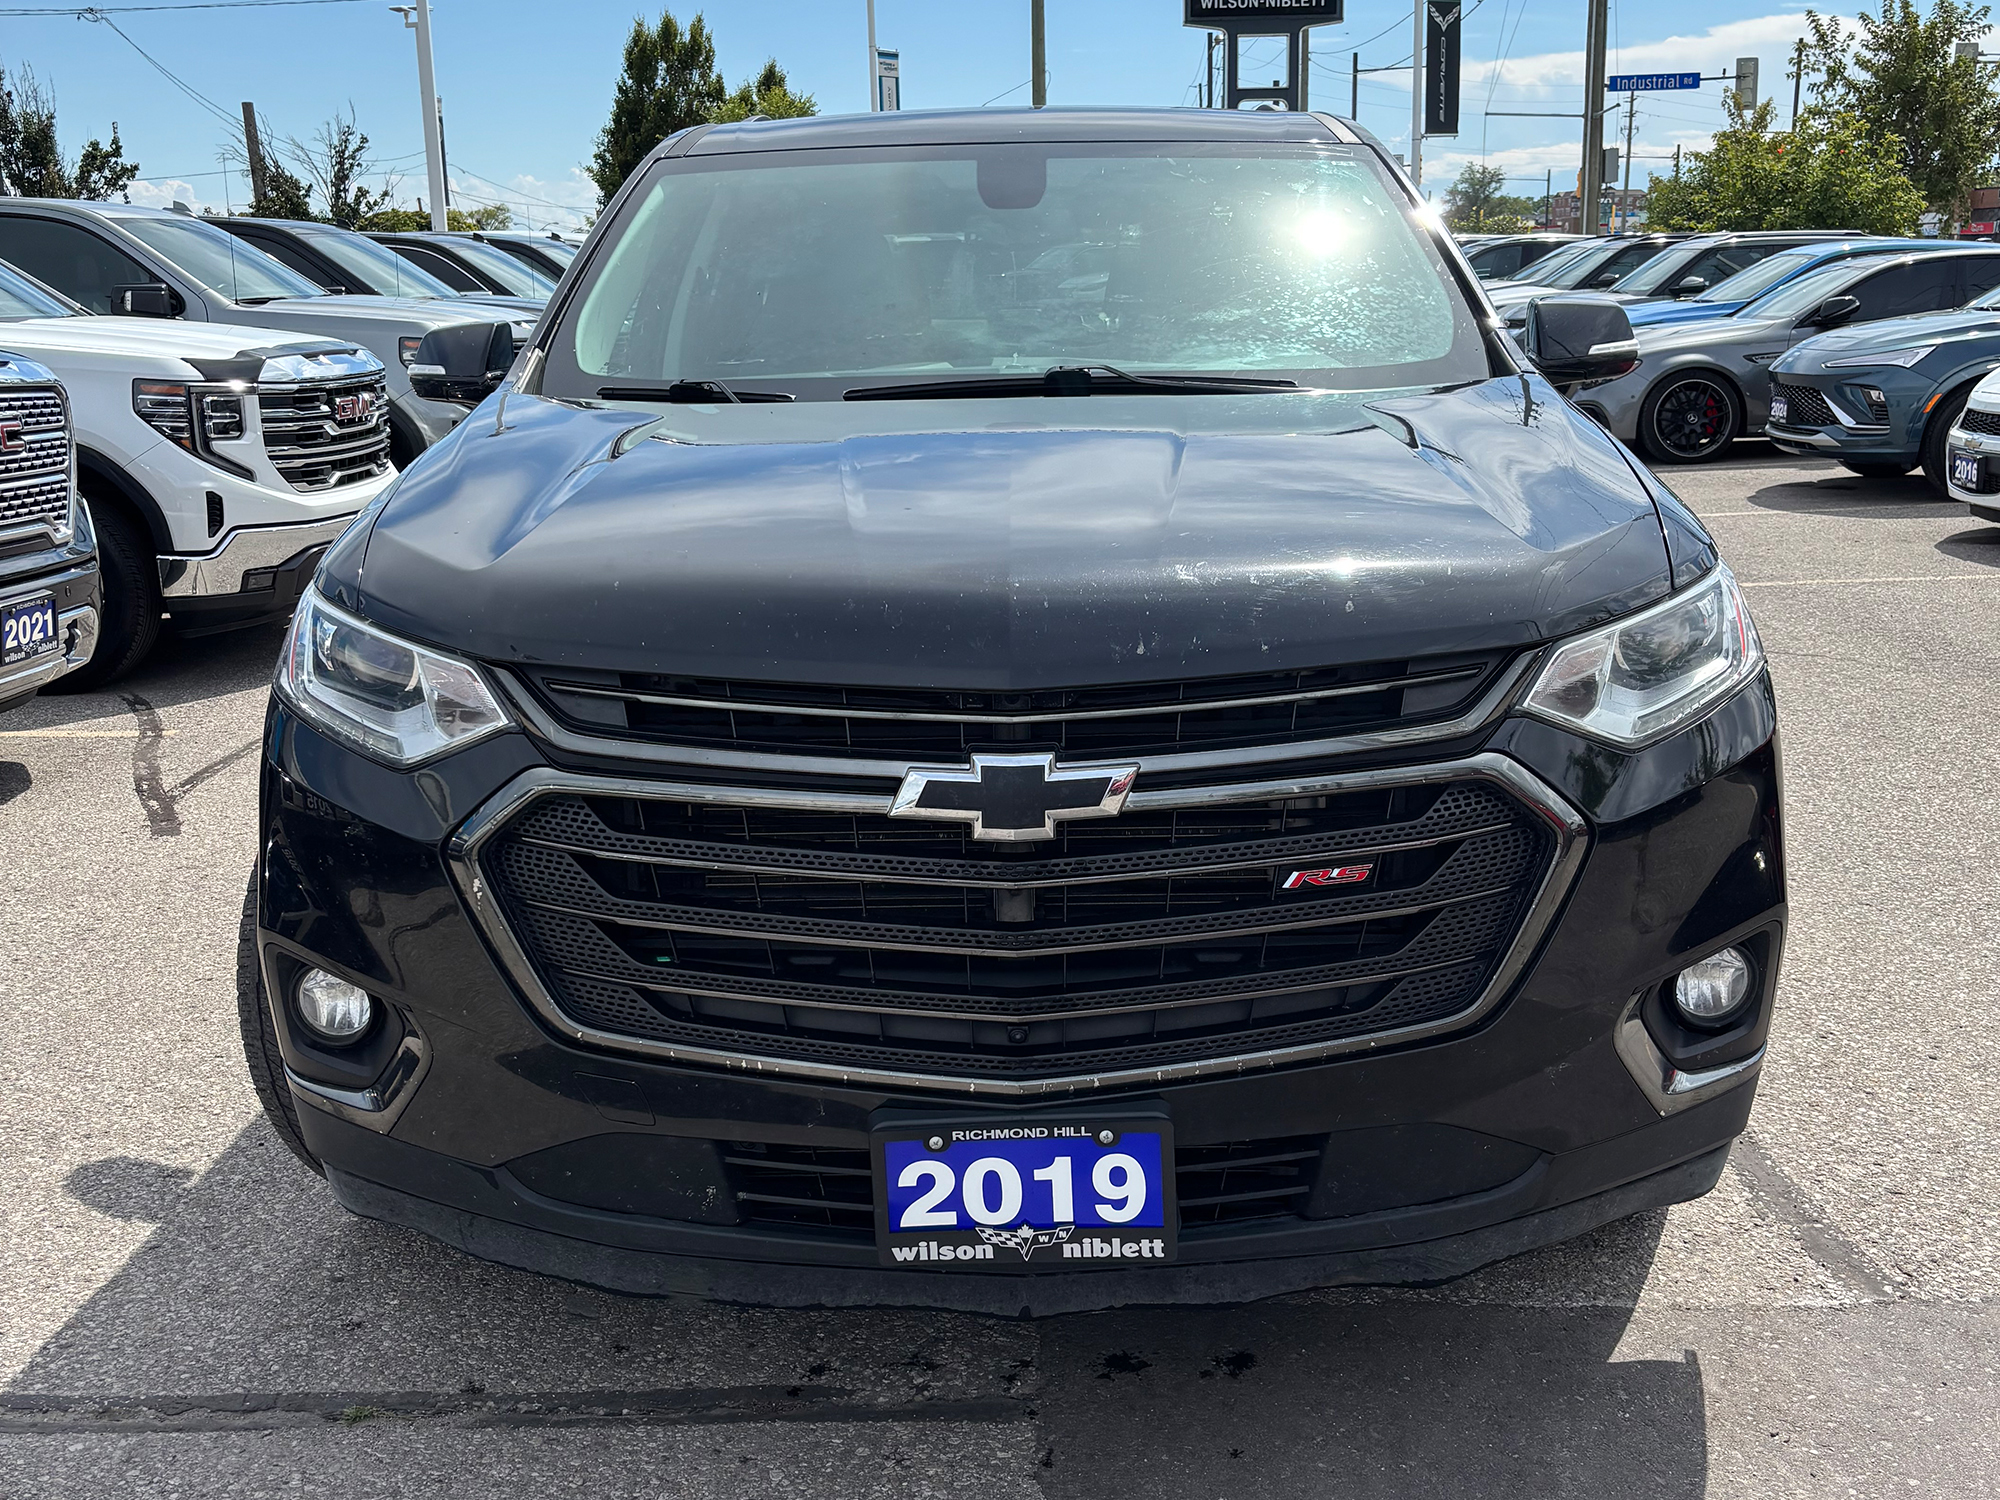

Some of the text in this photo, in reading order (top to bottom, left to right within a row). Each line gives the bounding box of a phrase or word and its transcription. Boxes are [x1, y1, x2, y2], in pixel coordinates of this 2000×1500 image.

[1617, 75, 1693, 90] Industrial Rd
[1771, 401, 1787, 418] 2024
[1955, 459, 1978, 482] 2016
[5, 609, 53, 649] 2021
[5, 652, 26, 663] wilson
[1282, 864, 1373, 888] RS
[952, 1126, 1092, 1141] RICHMOND HILL
[897, 1154, 1147, 1227] 2019
[1038, 1230, 1067, 1243] W N
[892, 1238, 1165, 1261] wilson niblett
